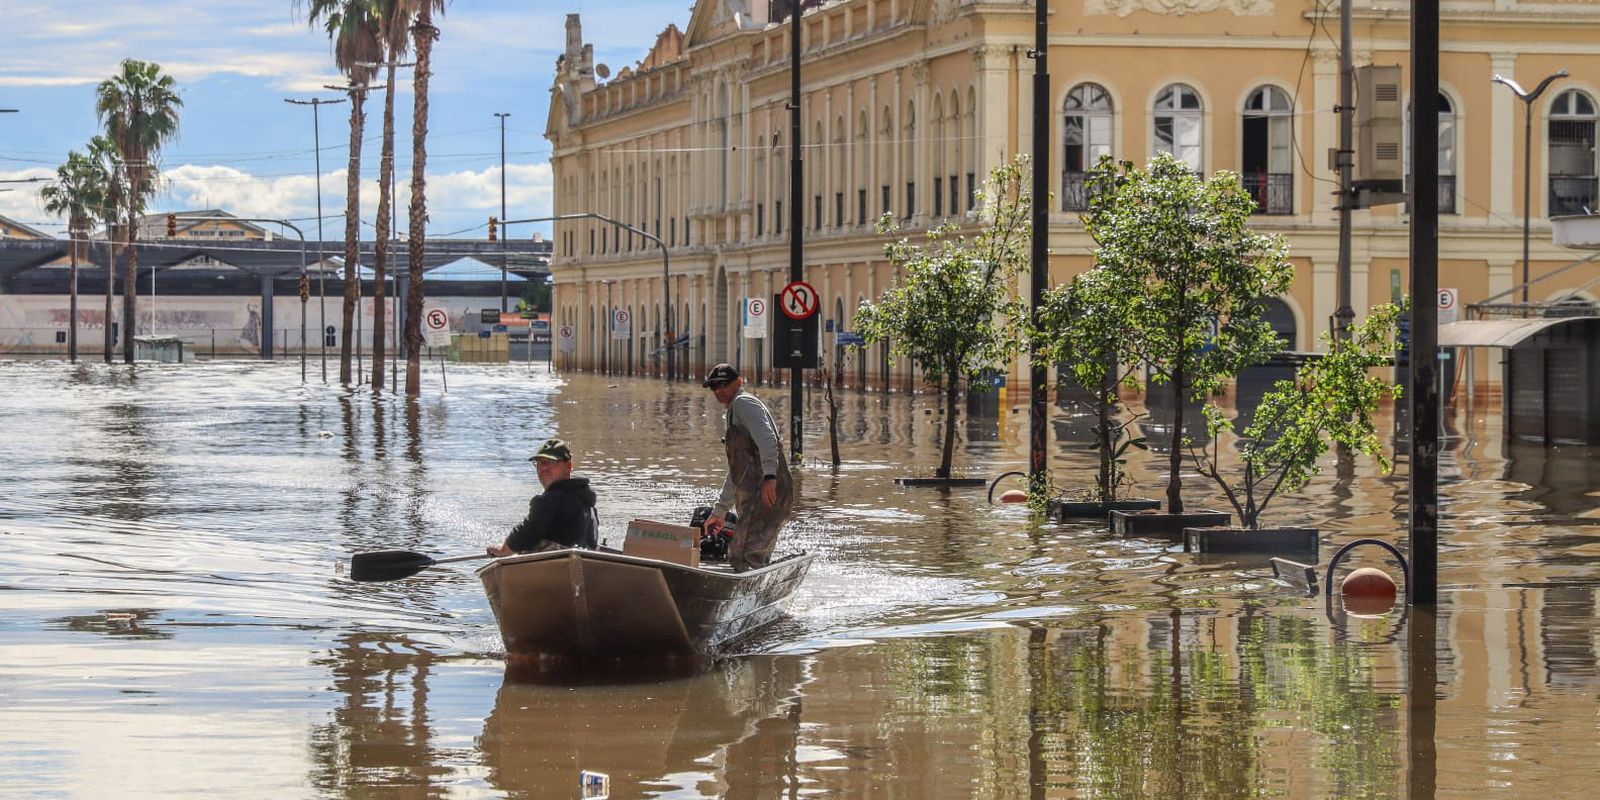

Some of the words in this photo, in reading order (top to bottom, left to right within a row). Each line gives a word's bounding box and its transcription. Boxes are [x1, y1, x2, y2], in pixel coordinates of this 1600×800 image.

[1440, 293, 1448, 305] E
[753, 303, 760, 313] E
[619, 313, 625, 321] E
